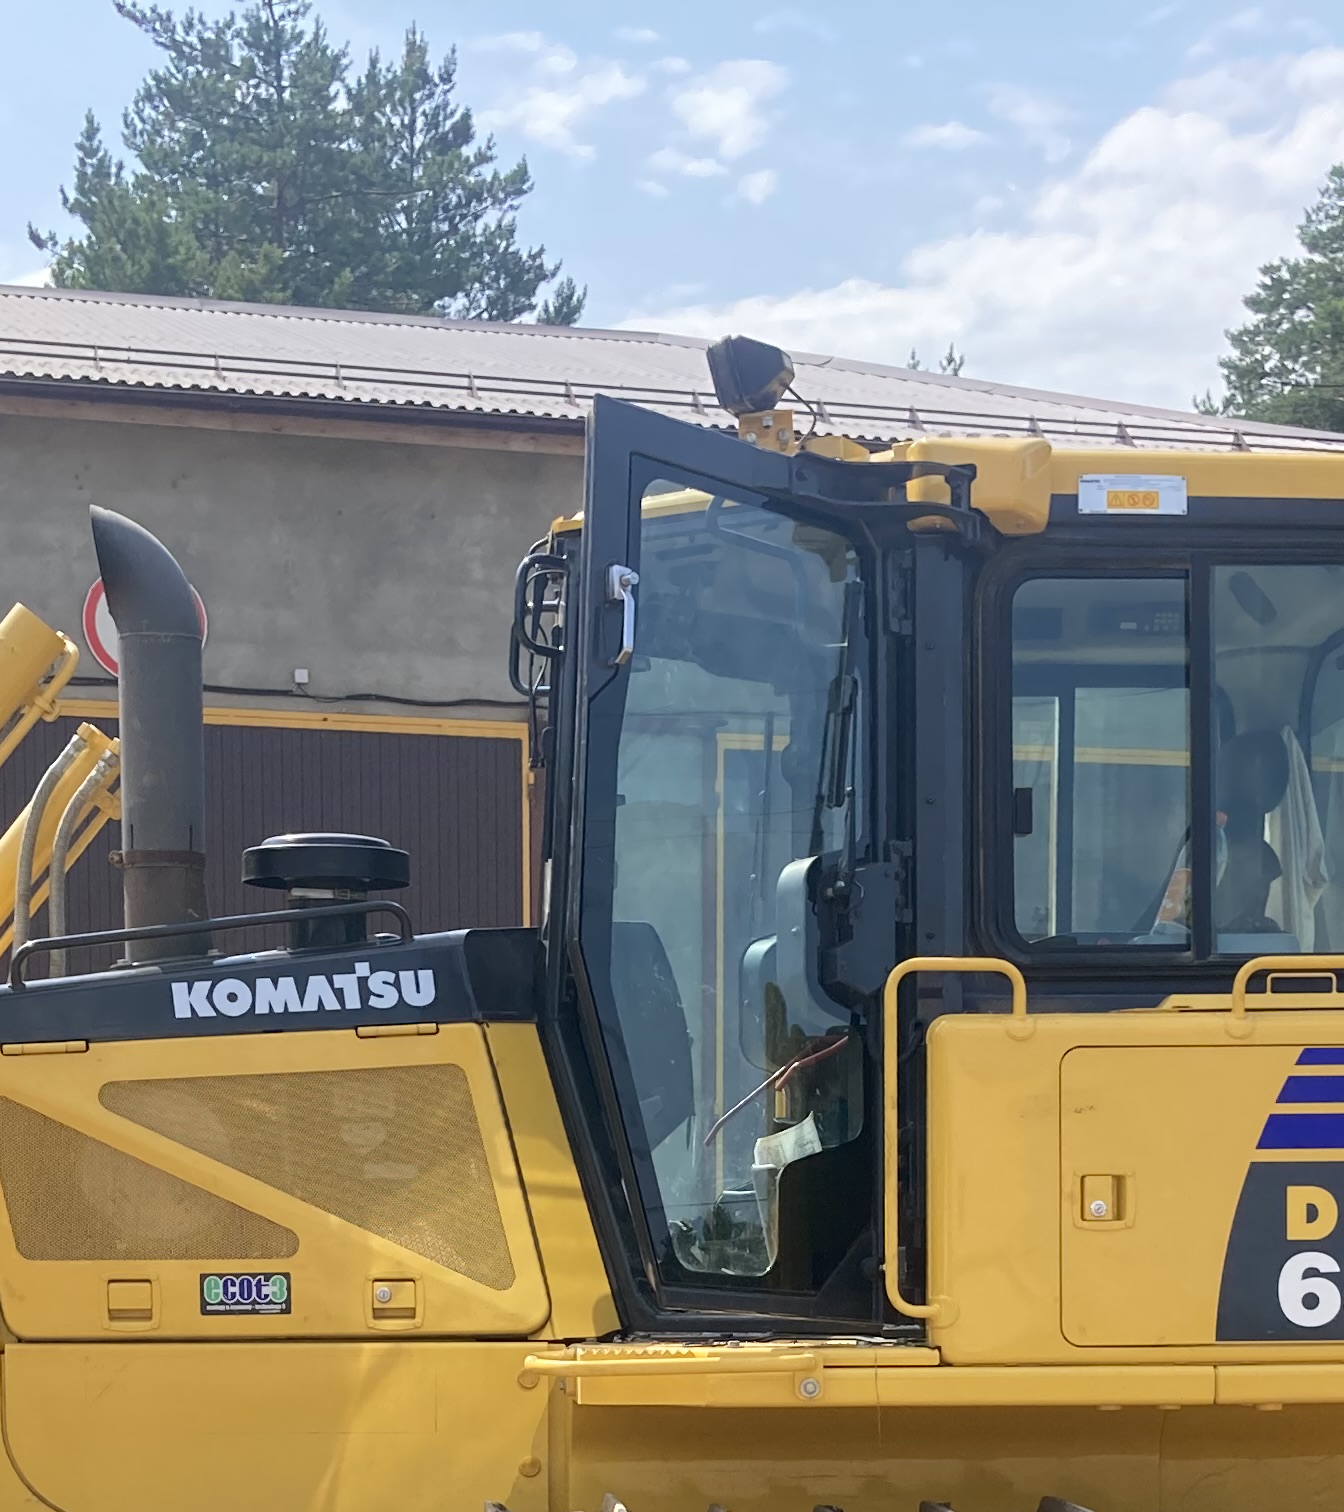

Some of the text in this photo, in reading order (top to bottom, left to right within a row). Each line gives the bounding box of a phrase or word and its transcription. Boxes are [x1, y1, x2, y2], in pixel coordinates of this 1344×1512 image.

[171, 962, 436, 1019] KOMATSU
[1286, 1185, 1338, 1240] D
[204, 1275, 288, 1304] ecot3
